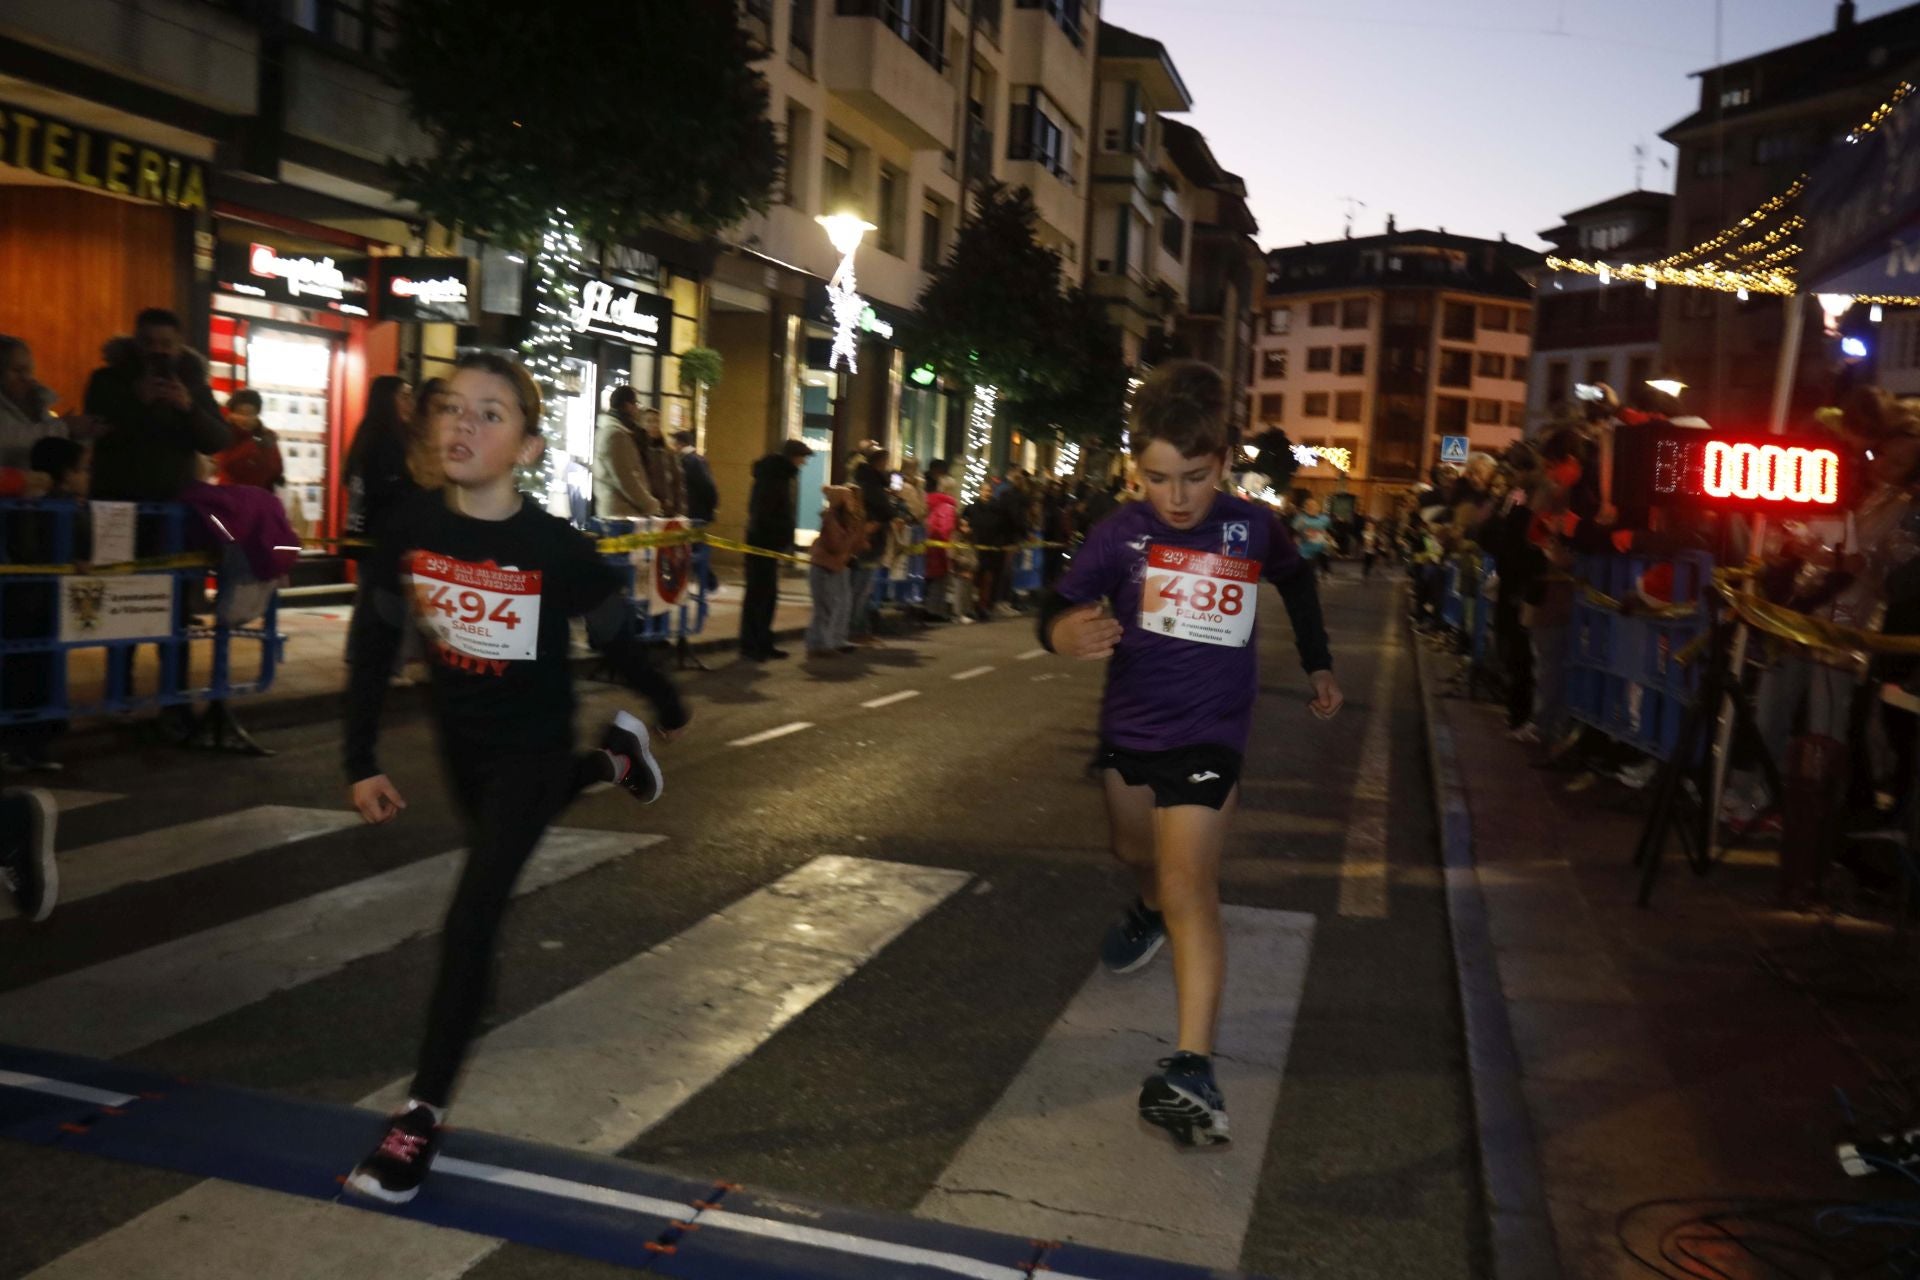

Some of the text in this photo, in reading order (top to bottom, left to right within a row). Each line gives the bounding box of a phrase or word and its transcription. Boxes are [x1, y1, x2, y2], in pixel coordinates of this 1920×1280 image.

[430, 586, 521, 630] 494
[1160, 575, 1244, 616] 488
[1176, 608, 1223, 624] PELAYO
